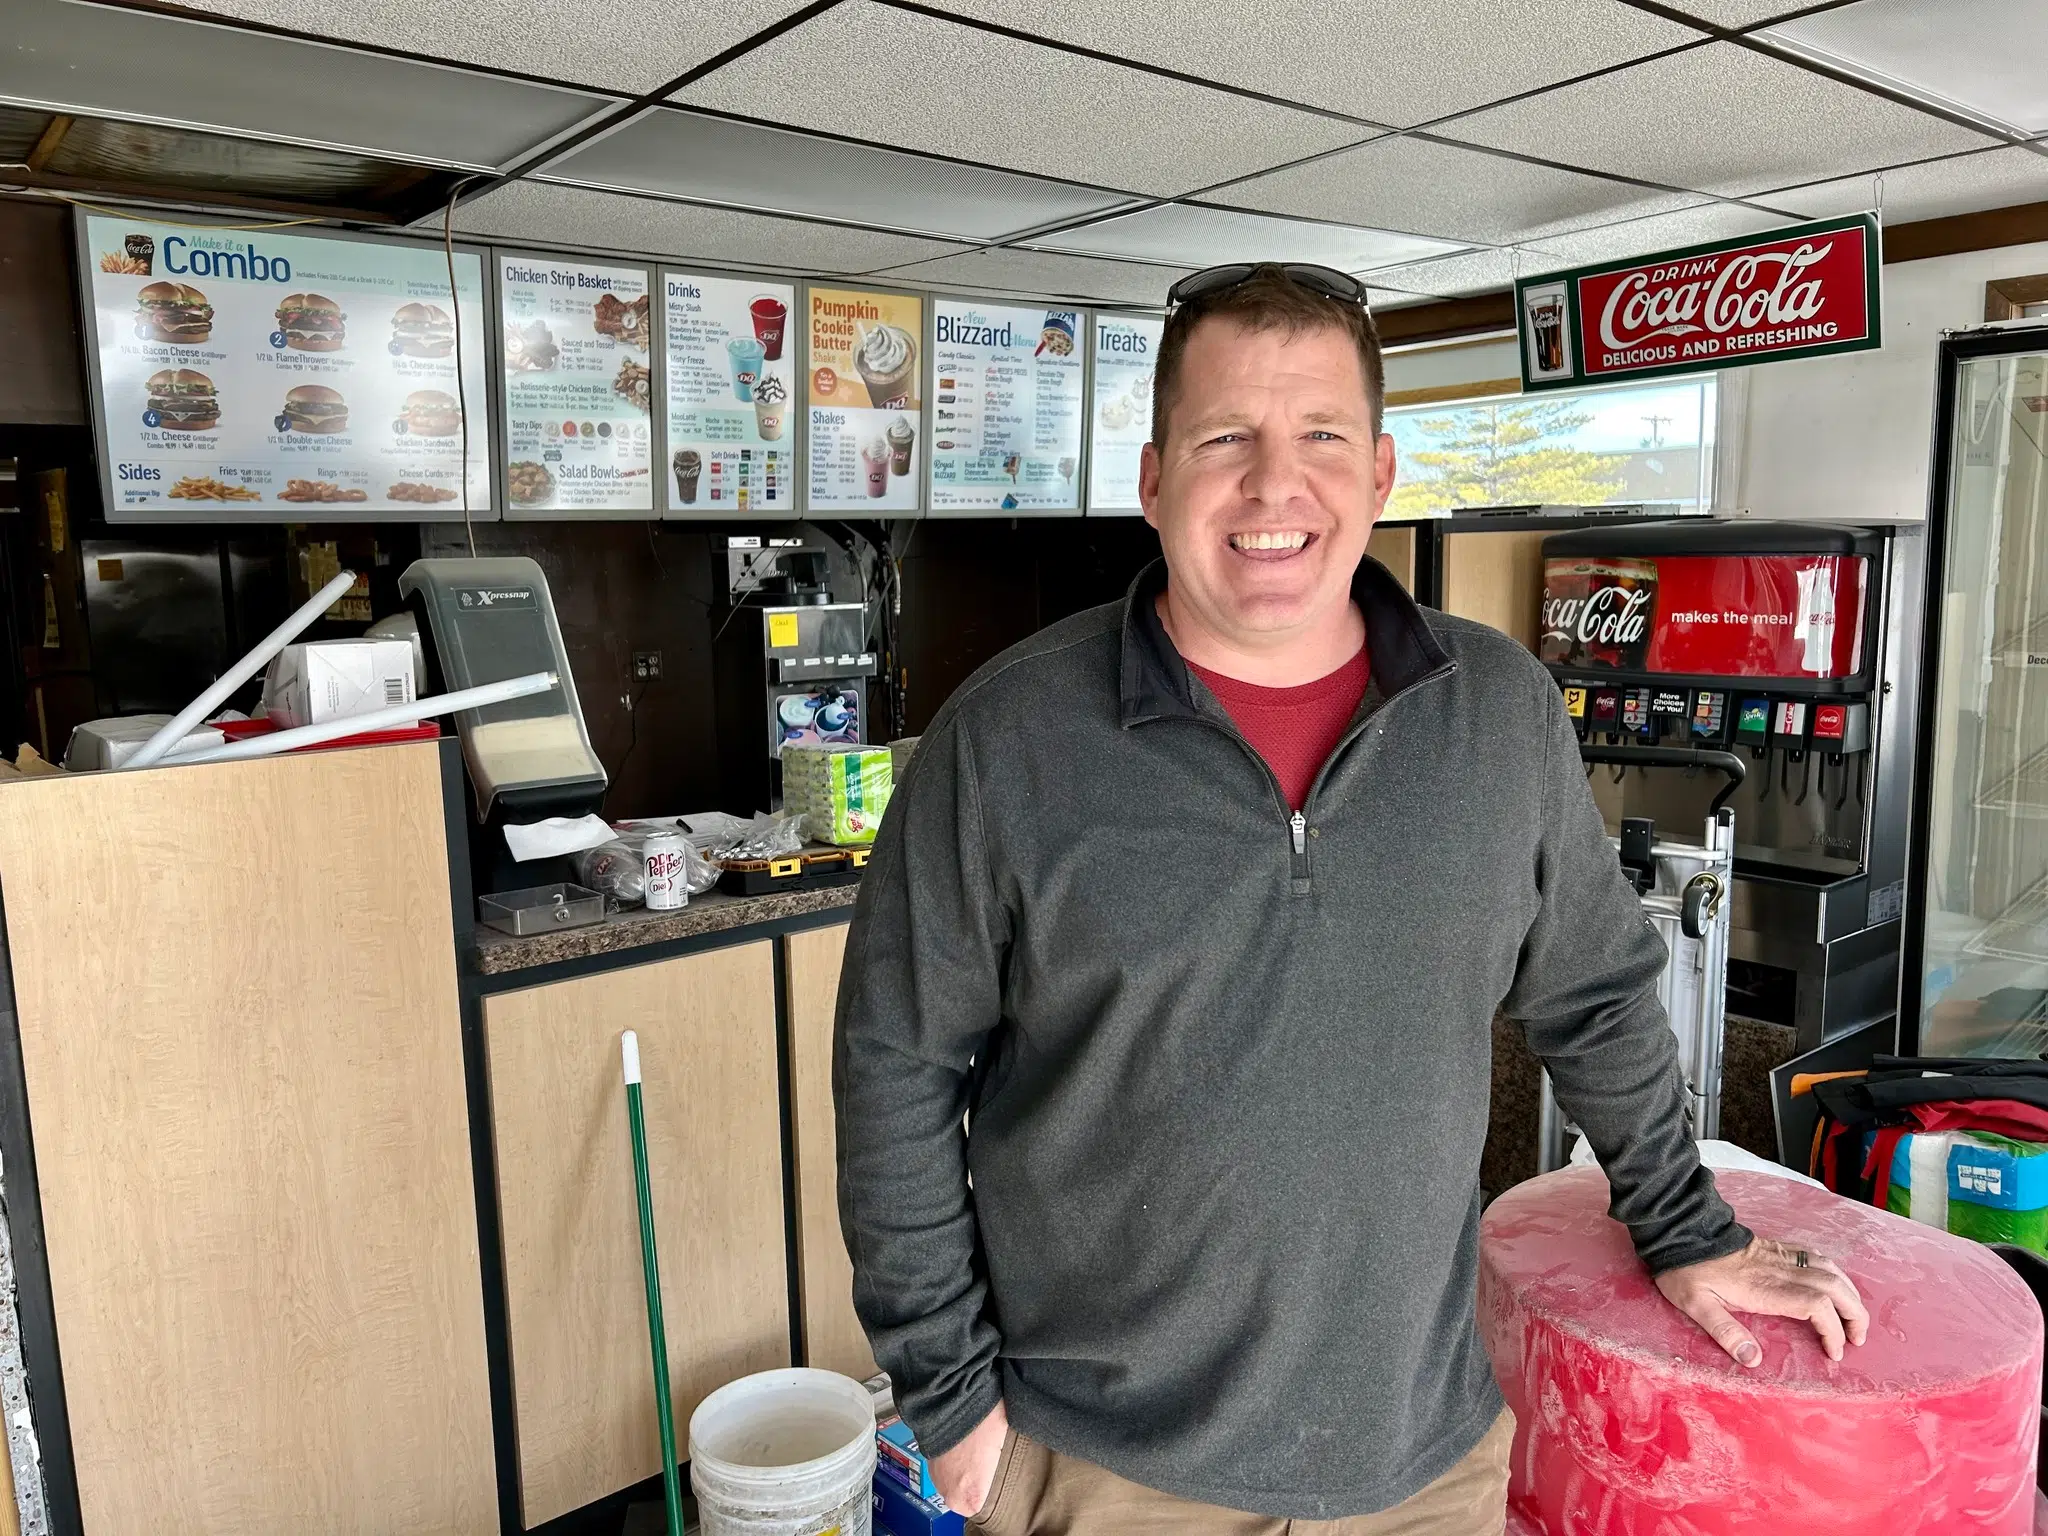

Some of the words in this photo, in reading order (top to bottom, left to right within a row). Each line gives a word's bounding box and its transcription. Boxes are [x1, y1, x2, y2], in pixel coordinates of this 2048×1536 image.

[189, 235, 222, 250] Make
[224, 238, 234, 251] it
[236, 243, 244, 251] a
[163, 236, 291, 283] Combo
[1651, 258, 1718, 284] DRINK
[506, 266, 548, 284] Chicken
[551, 270, 575, 289] Strip
[578, 273, 612, 290] Basket
[668, 282, 701, 298] Drinks
[669, 302, 684, 312] Misty
[686, 303, 701, 312] Slush
[813, 297, 879, 322] Pumpkin
[963, 311, 987, 325] New
[813, 319, 854, 336] Cookie
[937, 315, 1011, 348] Blizzard
[762, 331, 778, 340] DQ
[1098, 325, 1147, 353] Treats
[562, 338, 582, 348] Sauced
[584, 340, 594, 348] and
[596, 339, 615, 350] Tossed
[813, 335, 852, 351] Butter
[1602, 345, 1677, 367] DELICIOUS
[1682, 337, 1721, 357] AND
[1726, 321, 1838, 351] REFRESHING
[143, 346, 168, 356] Bacon
[170, 347, 199, 357] Cheese
[813, 352, 836, 363] Shake
[938, 351, 955, 360] Candy
[956, 352, 976, 360] Classics
[687, 356, 705, 365] Freeze
[740, 374, 755, 382] DQ
[568, 384, 591, 393] Chicken
[592, 385, 607, 394] Bites
[148, 413, 156, 425] 4
[813, 411, 846, 425] Shakes
[512, 420, 528, 430] Tasty
[529, 421, 542, 430] Dips
[162, 432, 191, 442] Cheese
[287, 435, 312, 444] Double
[711, 451, 722, 459] Soft
[723, 452, 739, 460] Drinks
[219, 466, 237, 475] Fries
[559, 464, 588, 479] Salad
[591, 465, 621, 479] Bowls
[934, 460, 954, 471] Royal
[118, 463, 161, 481] Sides
[318, 468, 337, 478] Rings
[477, 590, 530, 606] Xpressnap
[1672, 611, 1719, 624] makes
[1723, 611, 1749, 624] the
[1753, 611, 1793, 624] meal
[1659, 692, 1680, 700] More
[1653, 699, 1685, 707] Choices
[1666, 705, 1683, 713] You!
[658, 853, 674, 865] Dr
[646, 856, 683, 878] Pepper
[653, 884, 667, 892] Diet
